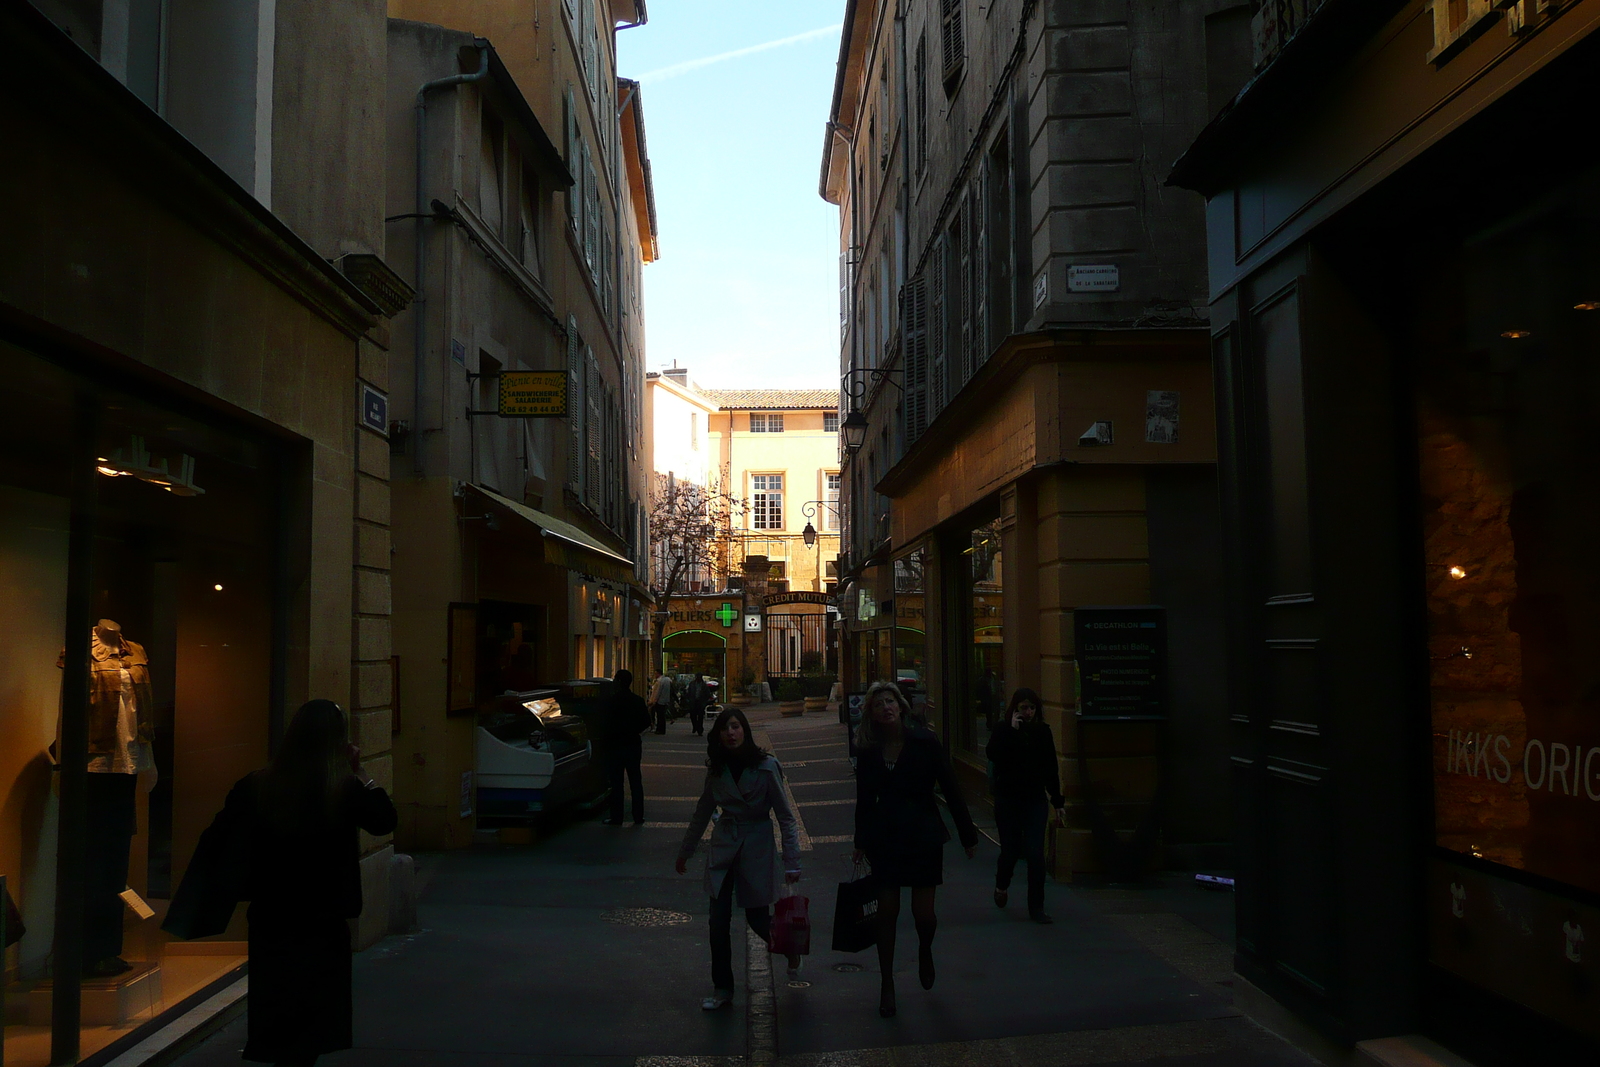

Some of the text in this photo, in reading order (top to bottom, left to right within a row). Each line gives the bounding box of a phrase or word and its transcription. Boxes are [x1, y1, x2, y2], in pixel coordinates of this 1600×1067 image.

[798, 593, 834, 604] MUTUE
[662, 610, 712, 622] PELIERS
[1447, 730, 1600, 802] IKKS ORIG
